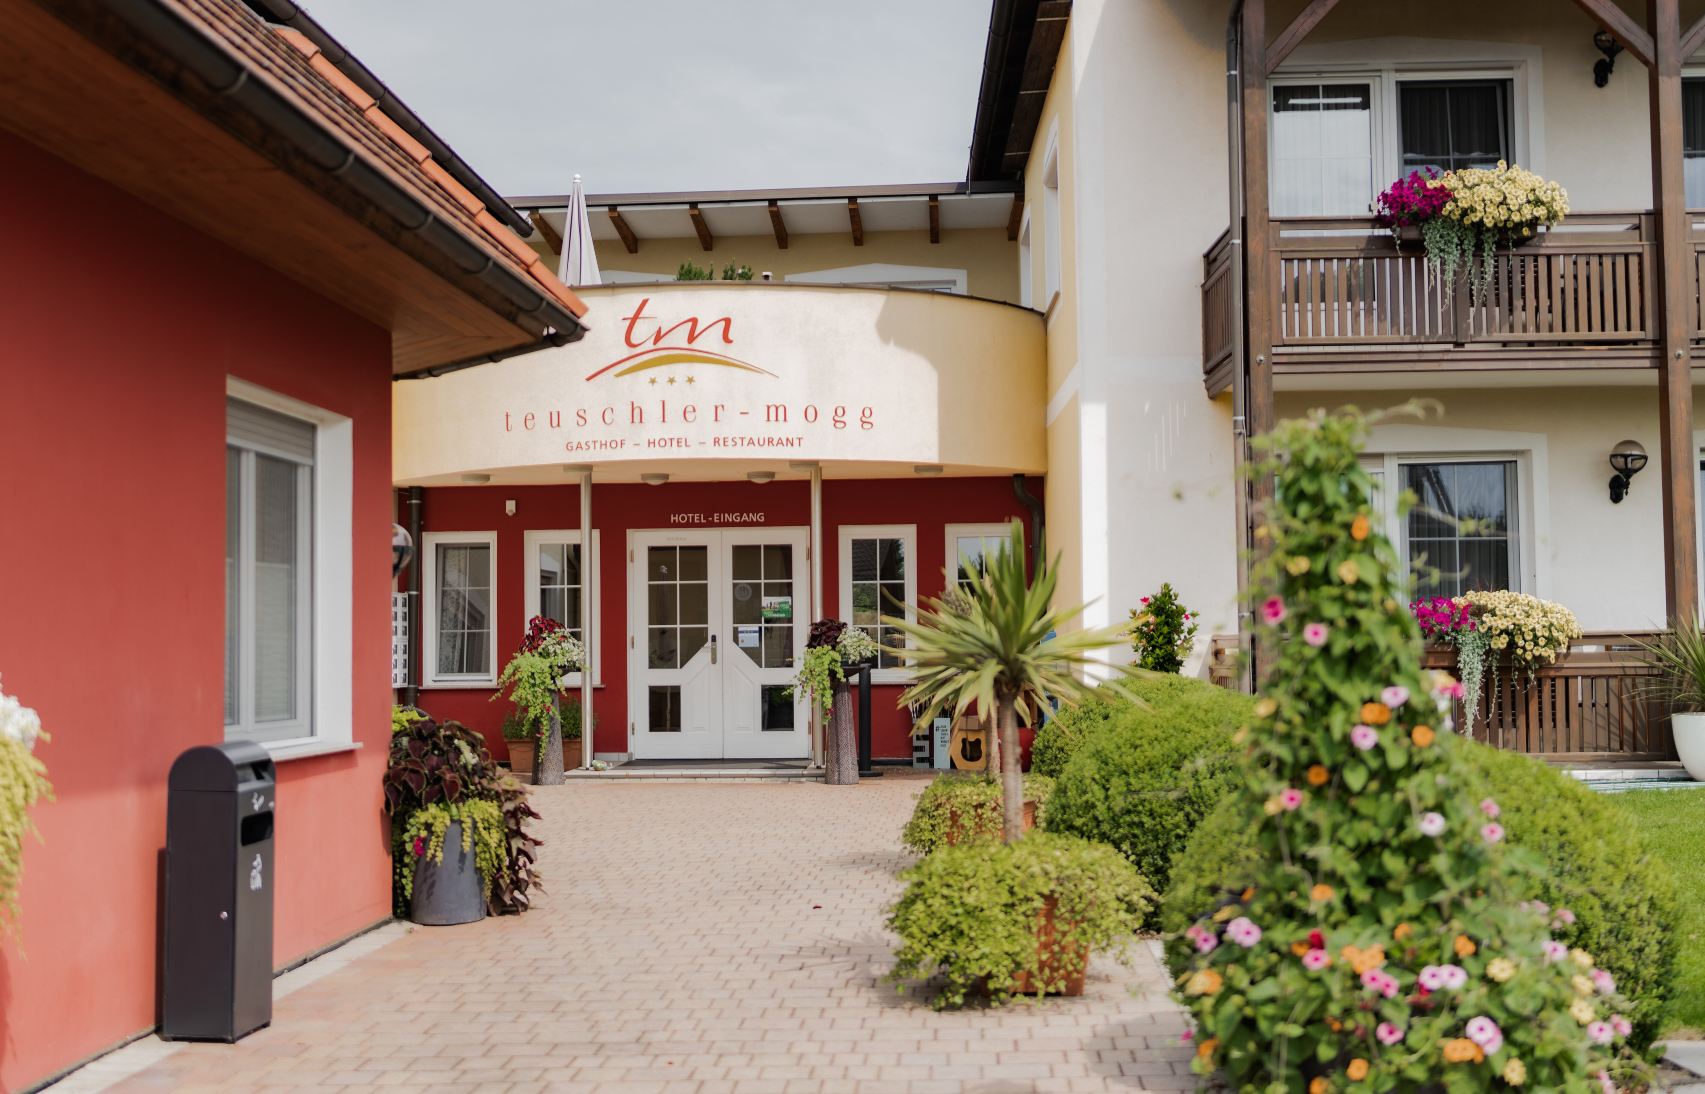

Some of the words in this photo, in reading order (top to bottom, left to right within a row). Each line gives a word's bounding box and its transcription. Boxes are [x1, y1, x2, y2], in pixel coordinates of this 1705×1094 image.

[622, 298, 734, 348] tm
[504, 399, 875, 432] teuschler-mogg
[565, 438, 627, 452] GASTHOF
[647, 437, 691, 449] HOTEL
[712, 436, 804, 449] RESTAURANT
[670, 512, 766, 524] HOTEL-EINGANG
